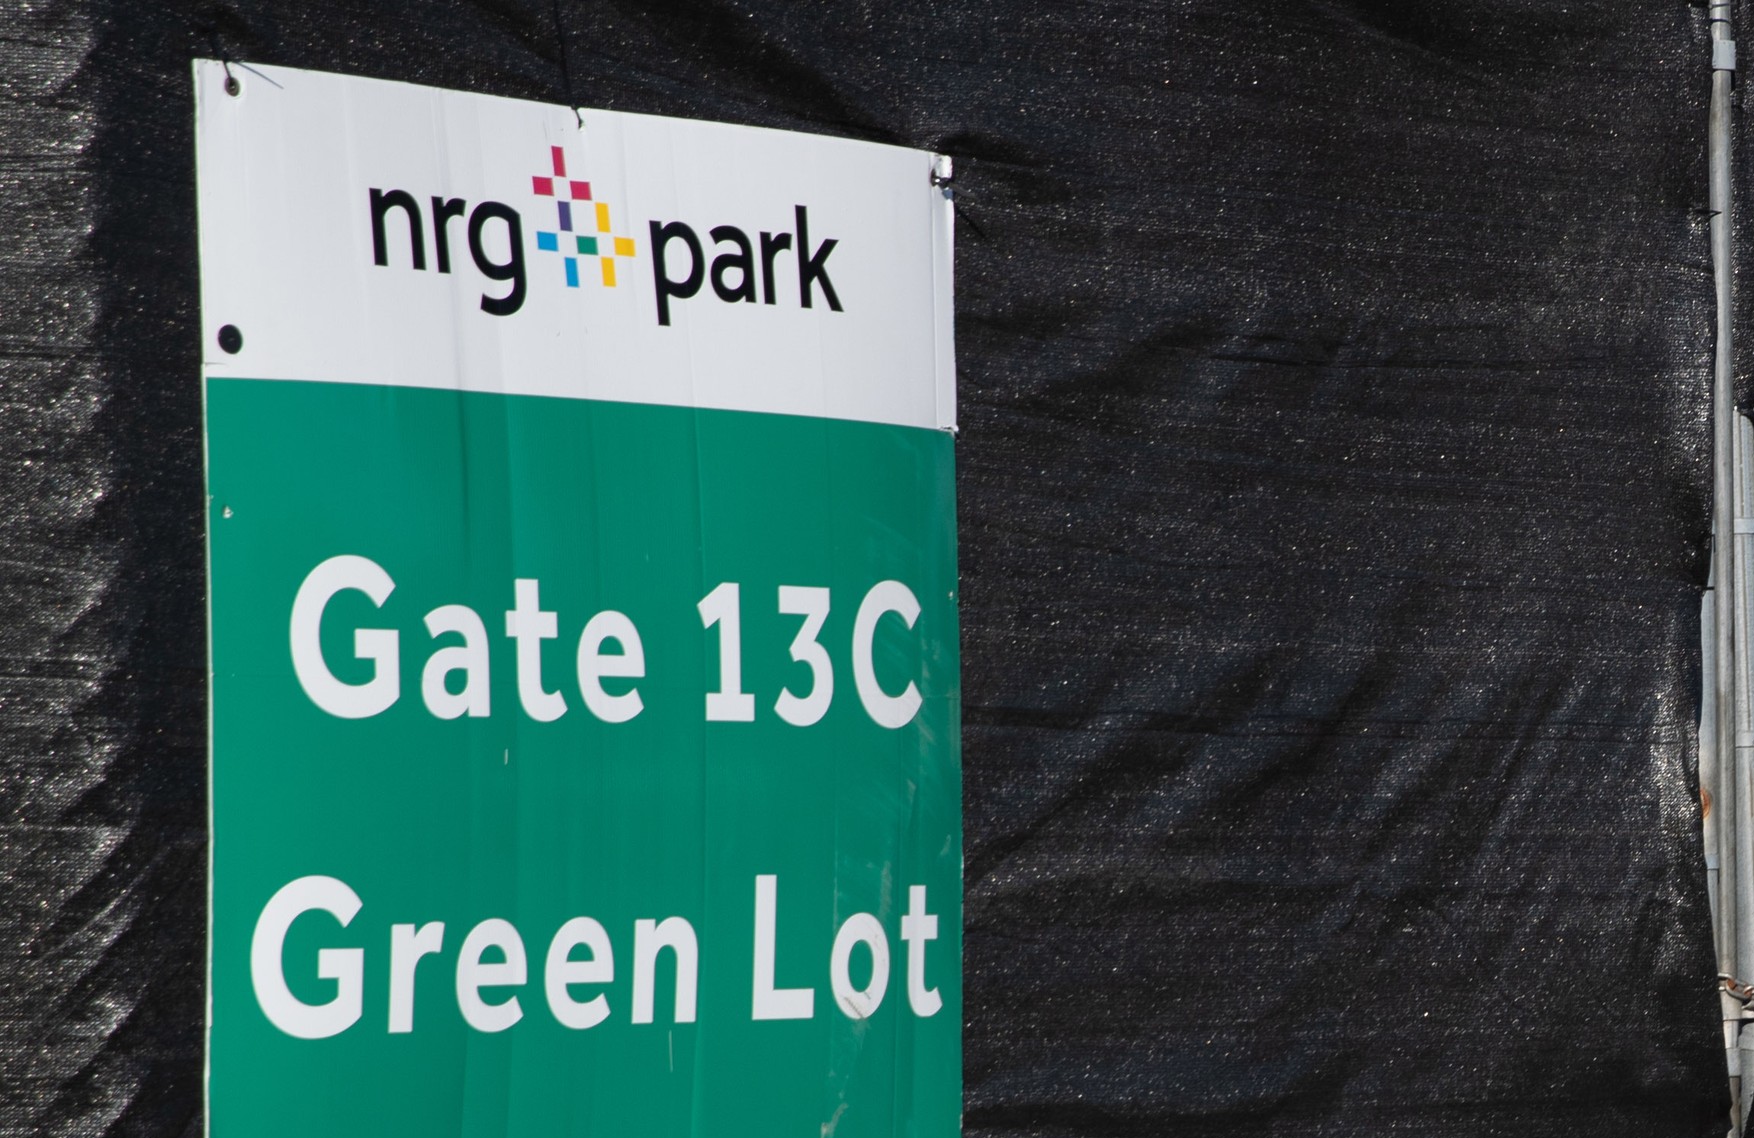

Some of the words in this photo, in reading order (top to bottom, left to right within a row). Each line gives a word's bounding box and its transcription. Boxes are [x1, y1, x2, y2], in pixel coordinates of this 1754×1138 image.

[368, 187, 527, 316] nrg
[648, 204, 844, 327] park
[289, 554, 646, 724] Gate
[696, 579, 924, 729] 13C
[250, 874, 699, 1040] Green
[751, 874, 943, 1020] Lot
